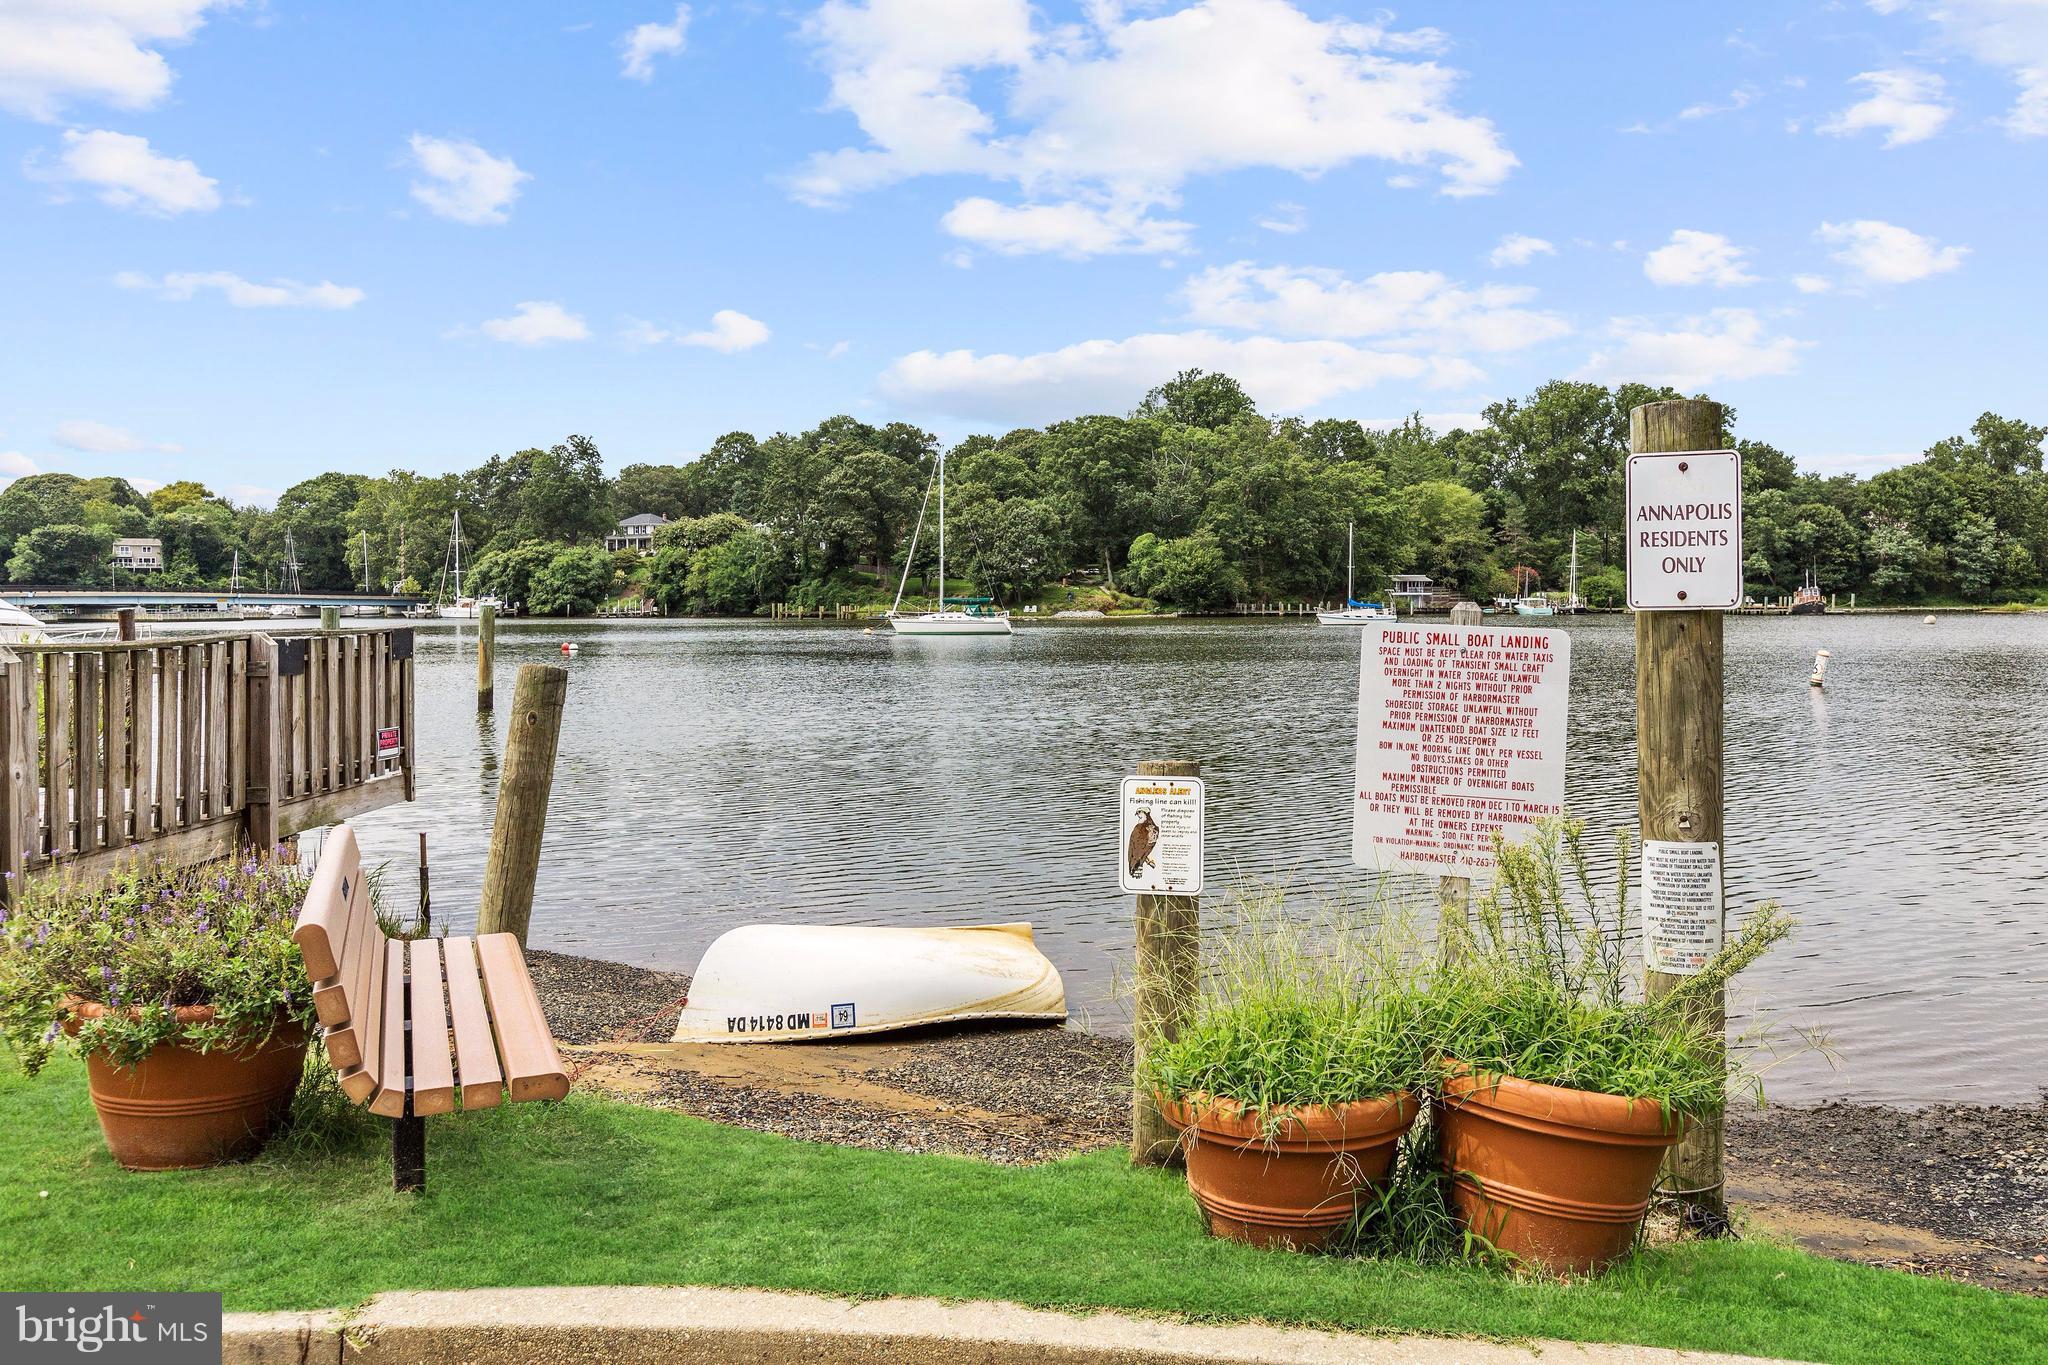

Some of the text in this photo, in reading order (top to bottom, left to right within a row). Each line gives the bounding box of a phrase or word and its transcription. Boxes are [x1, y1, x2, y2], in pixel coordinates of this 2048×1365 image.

[1637, 503, 1732, 521] ANNAPOLIS
[1640, 530, 1728, 547] RESIDENTS
[1662, 557, 1706, 573] ONLY
[1382, 631, 1549, 649] PUBLIC SMALL BOAT LANDING
[1378, 647, 1554, 662] SPACE MUST BE KEPT CLEAR FOR WATER TAXIS
[1384, 658, 1544, 672] AND LOADING OF TRANSIENT SMALL CRAFT
[1384, 668, 1541, 684] OVERNIGHT IN WATER STORAGE UNLAWFUL
[1392, 679, 1533, 694] MORE THAN 2 NIGHTS WITHOUT PRIOR
[1403, 690, 1520, 704] PERMISSION OF HARBORMASTER
[1385, 700, 1538, 716] SHORESIDE STORAGE UNLAWFUL WITHOUT
[1389, 711, 1533, 727] PRIOR PERMISSION OF HARBORMASTER
[1382, 721, 1539, 738] MAXIMUM UNATTENDED BOAT SIZE 12 FEET
[1421, 733, 1497, 747] OR 25 HORSEPOWER
[1379, 741, 1393, 750] BOW
[1422, 745, 1453, 754] MOORING
[1456, 746, 1471, 755] LINE
[1475, 747, 1495, 757] ONLY
[1499, 749, 1513, 758] PER
[1517, 750, 1543, 760] VESSEL
[1411, 753, 1420, 761] NO
[1448, 756, 1472, 765] STAKES
[1474, 758, 1484, 767] OR
[1487, 758, 1509, 768] OTHER
[1411, 764, 1507, 778] OBSTRUCTIONS PERMITTED
[1382, 772, 1535, 792] MAXIMUM NUMBER OF OVERNIGHT BOATS
[1391, 783, 1437, 794] PERMISSIBLE
[1130, 798, 1154, 806] Fishing
[1360, 791, 1560, 815] ALL BOATS MUST BE REMOVED FROM DEC 1 TO MARCH 15
[1369, 803, 1380, 812] OR
[1383, 804, 1400, 814] THEY
[1404, 806, 1420, 815] WILL
[1424, 808, 1434, 817] BE
[1438, 809, 1470, 819] REMOVED
[1474, 811, 1484, 820] BY
[1409, 818, 1417, 826] AT
[1422, 819, 1434, 828] THE
[1438, 820, 1467, 831] OWNERS
[1405, 829, 1433, 837] WARNING
[1442, 831, 1456, 839] $100
[1460, 833, 1474, 841] FINE
[1477, 834, 1489, 842] PER
[727, 1017, 746, 1033] DA
[750, 1014, 784, 1032] 8414
[787, 1013, 810, 1030] MD
